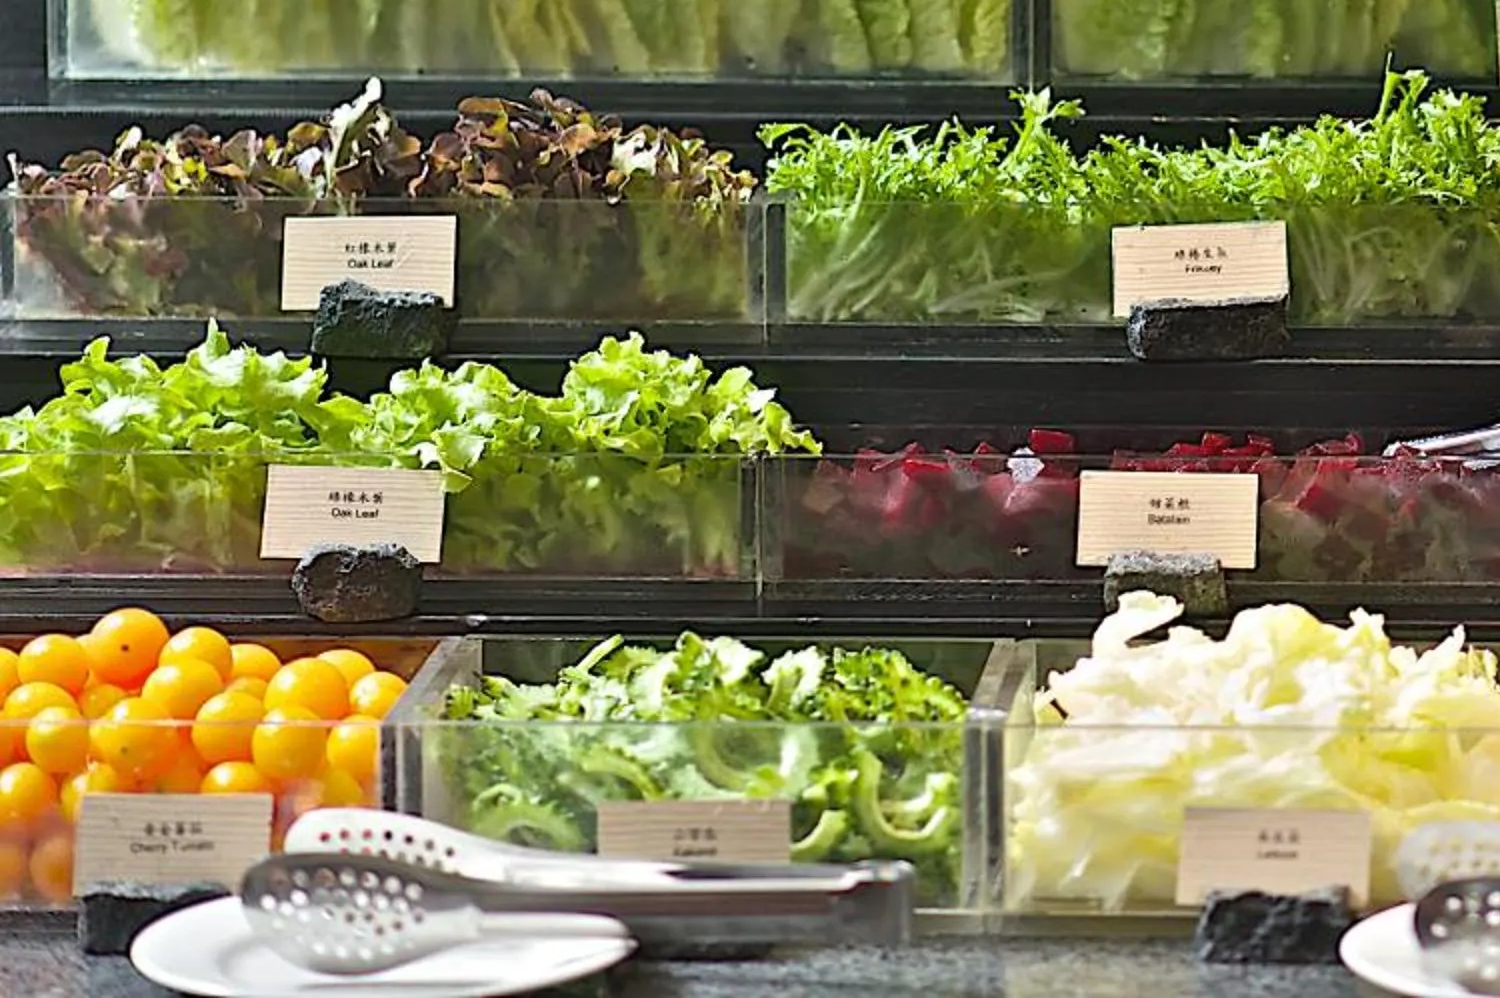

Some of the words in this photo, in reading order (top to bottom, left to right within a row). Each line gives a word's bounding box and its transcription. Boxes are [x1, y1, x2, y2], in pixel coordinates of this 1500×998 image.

[347, 258, 369, 269] Oak
[371, 259, 394, 269] Leaf
[331, 507, 352, 519] Oak
[355, 509, 379, 519] Leaf
[130, 842, 167, 855] Cherry
